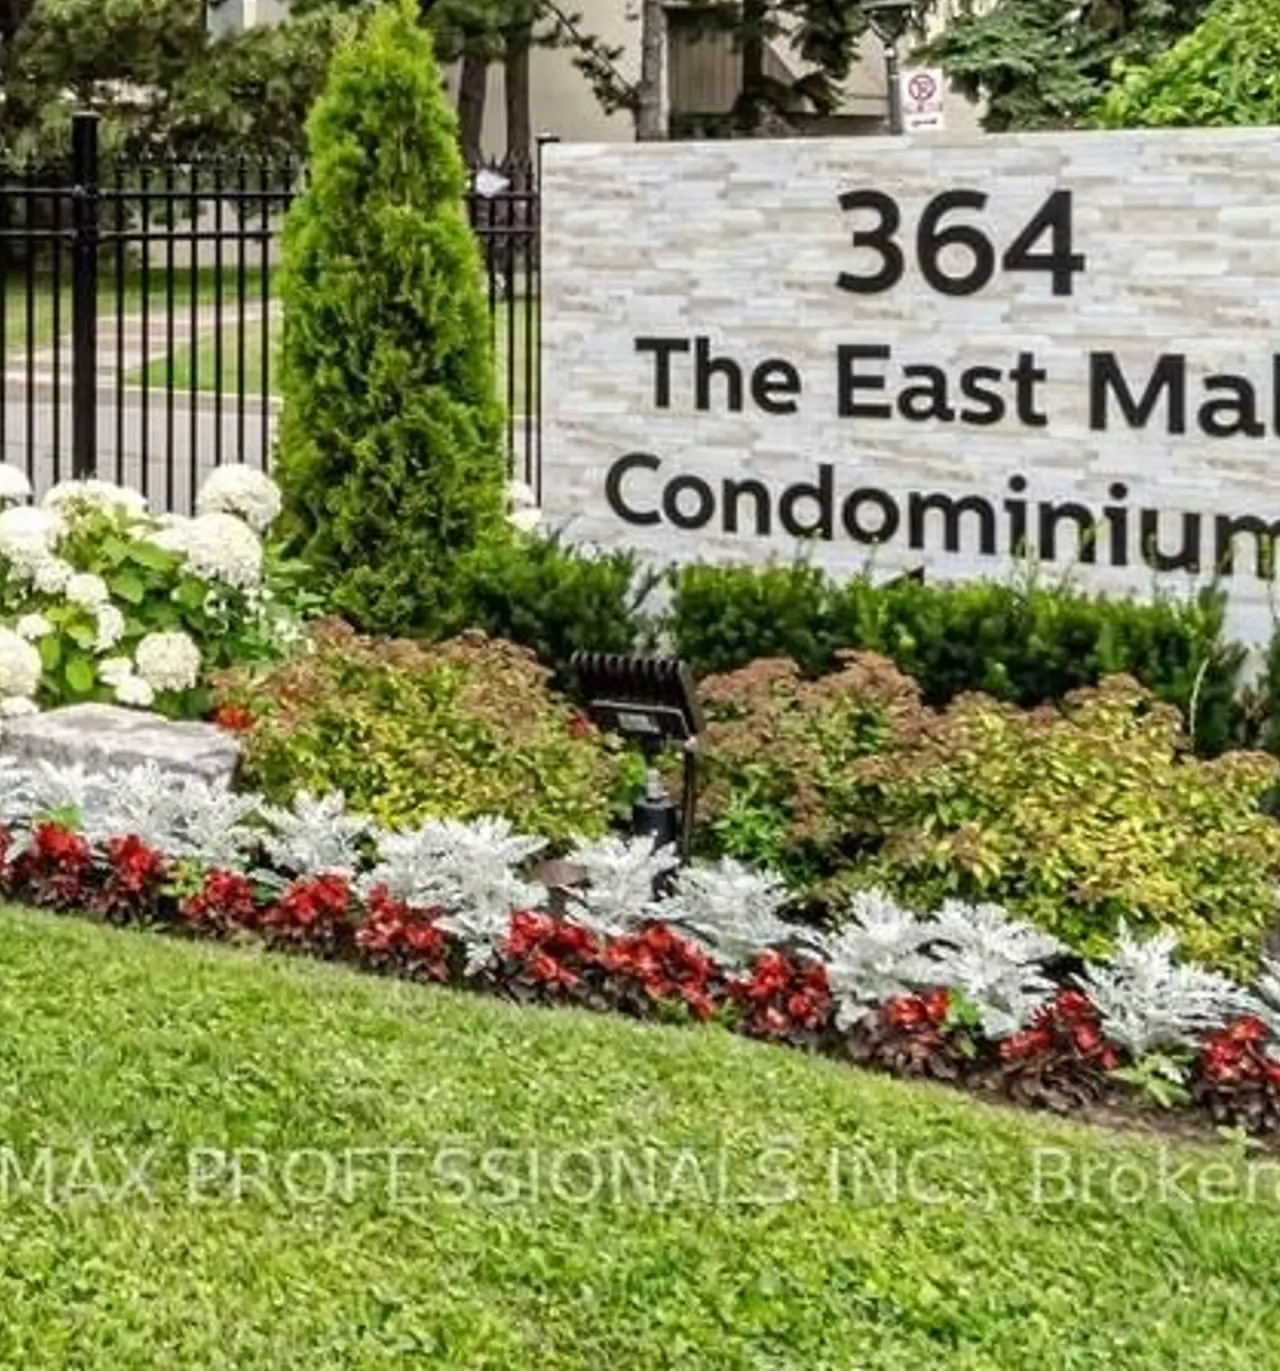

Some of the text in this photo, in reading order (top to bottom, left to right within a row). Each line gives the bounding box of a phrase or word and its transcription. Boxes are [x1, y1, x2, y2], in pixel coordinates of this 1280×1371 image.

[835, 189, 1086, 297] 364
[634, 336, 802, 415] The
[836, 343, 1048, 428] East
